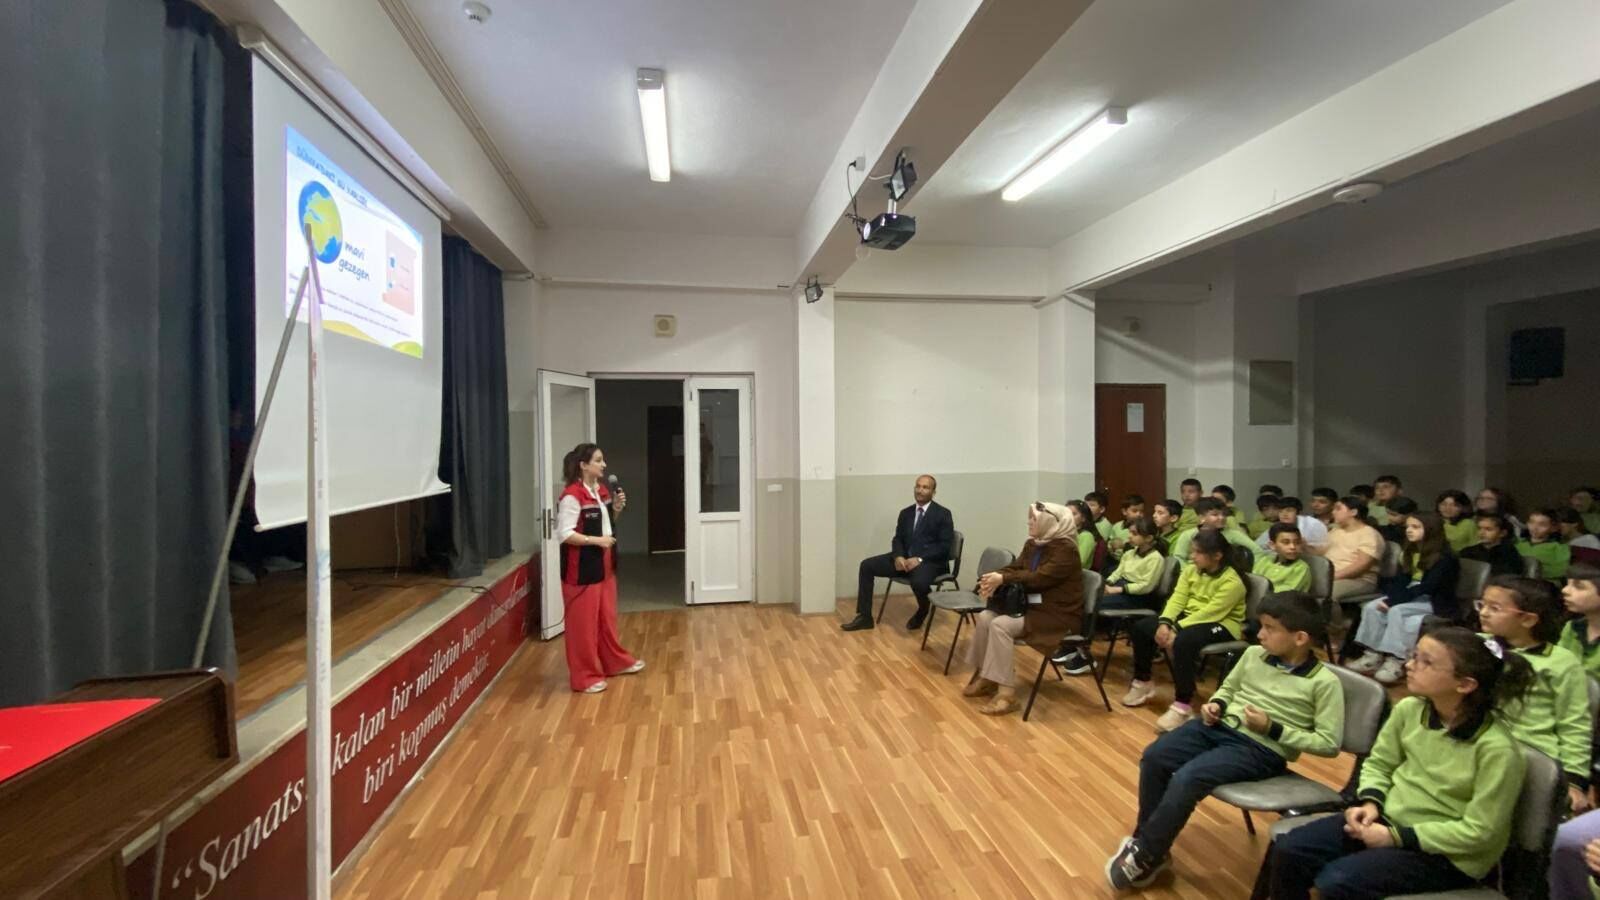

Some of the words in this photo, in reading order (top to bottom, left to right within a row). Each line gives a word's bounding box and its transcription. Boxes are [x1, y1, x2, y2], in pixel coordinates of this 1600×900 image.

[338, 258, 370, 281] gezegen
[344, 242, 366, 261] mavi
[171, 776, 308, 900] “Sanats
[332, 707, 386, 776] kalan
[391, 681, 413, 720] bir
[416, 640, 460, 698] milletin
[363, 743, 395, 804] biri
[399, 697, 447, 766] kopmuş
